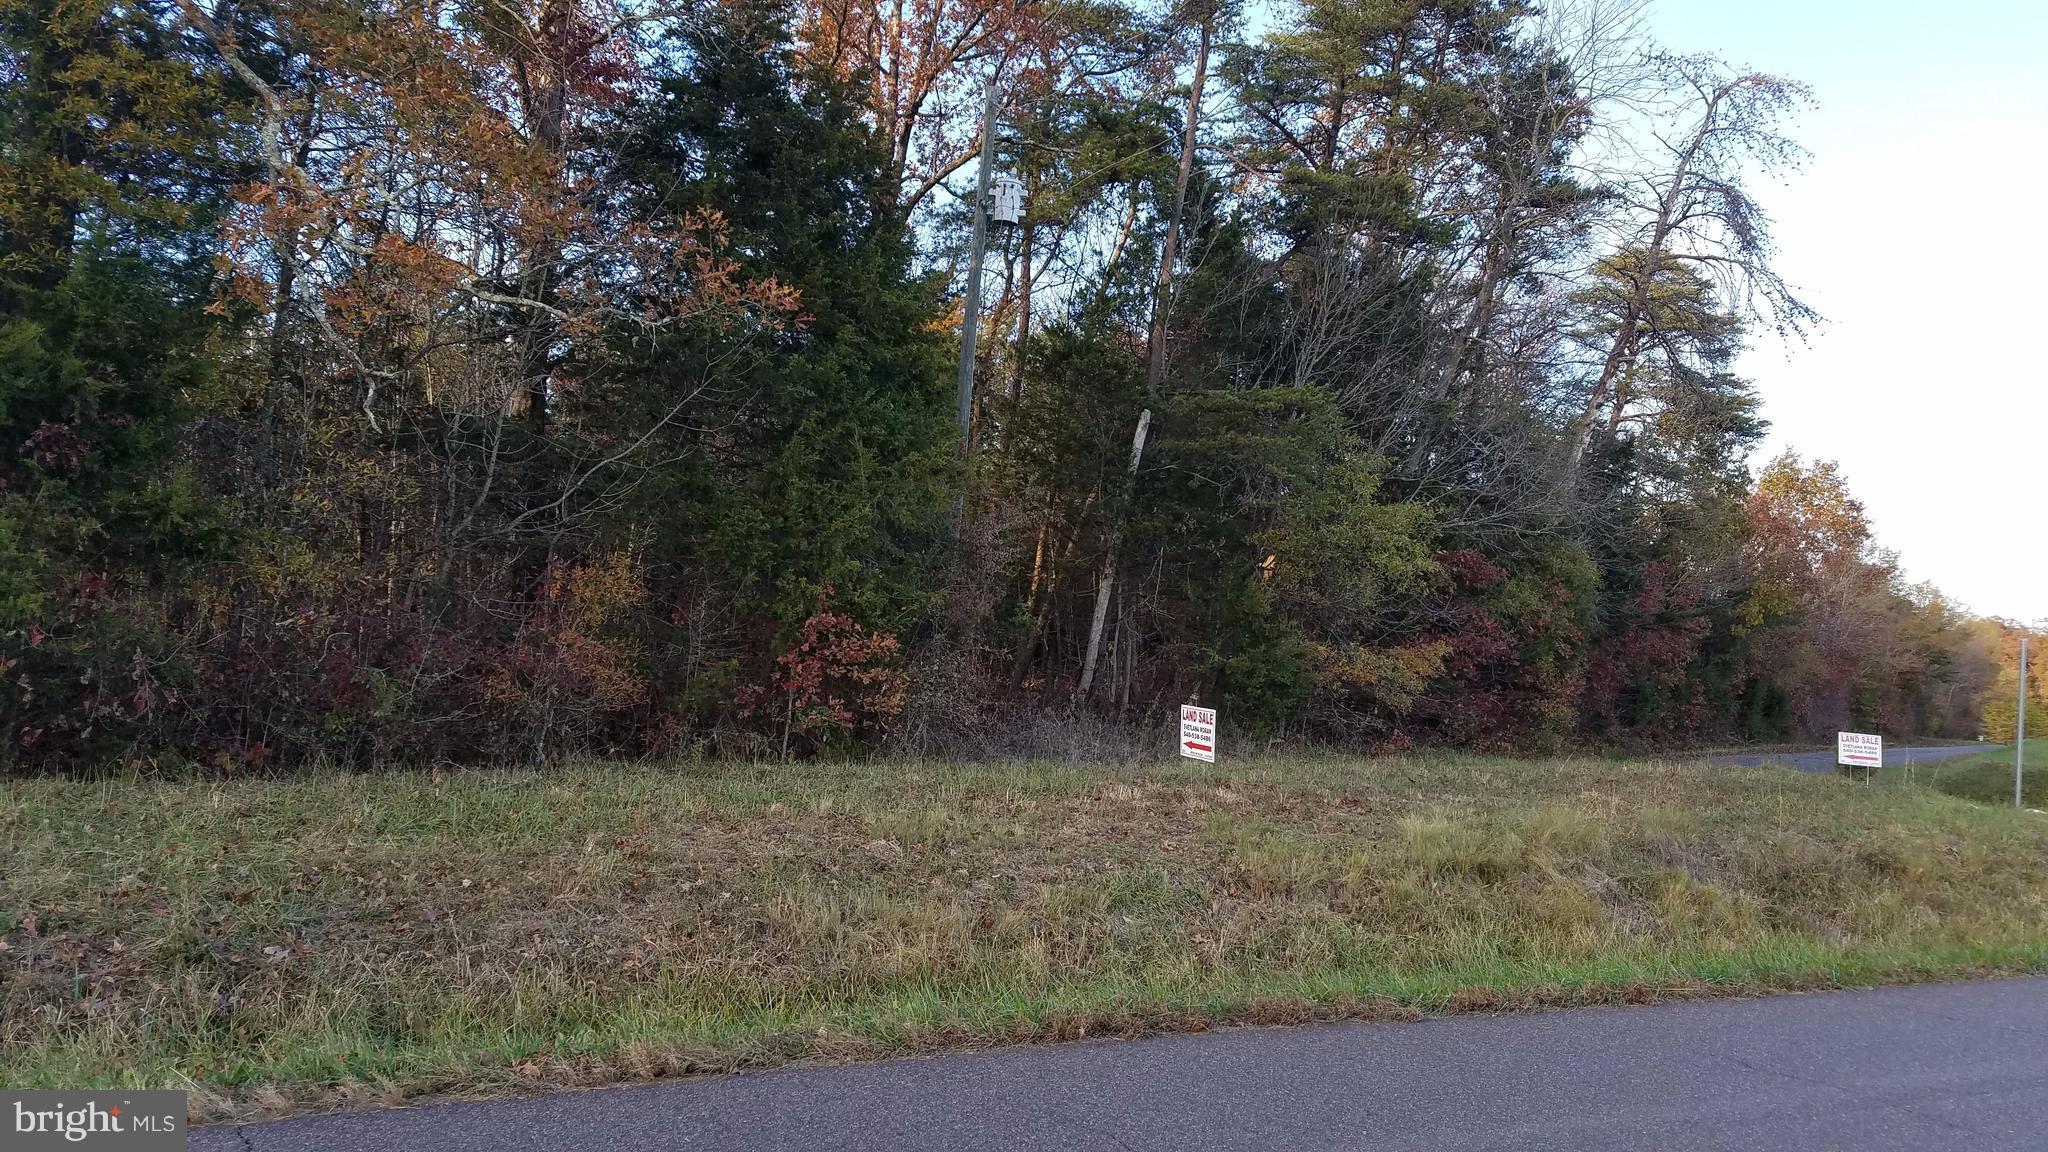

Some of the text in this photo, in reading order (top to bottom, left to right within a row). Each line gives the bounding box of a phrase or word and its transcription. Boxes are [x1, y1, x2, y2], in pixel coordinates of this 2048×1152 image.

[1182, 709, 1214, 725] LAND SALE
[1841, 735, 1879, 745] LAND SALE
